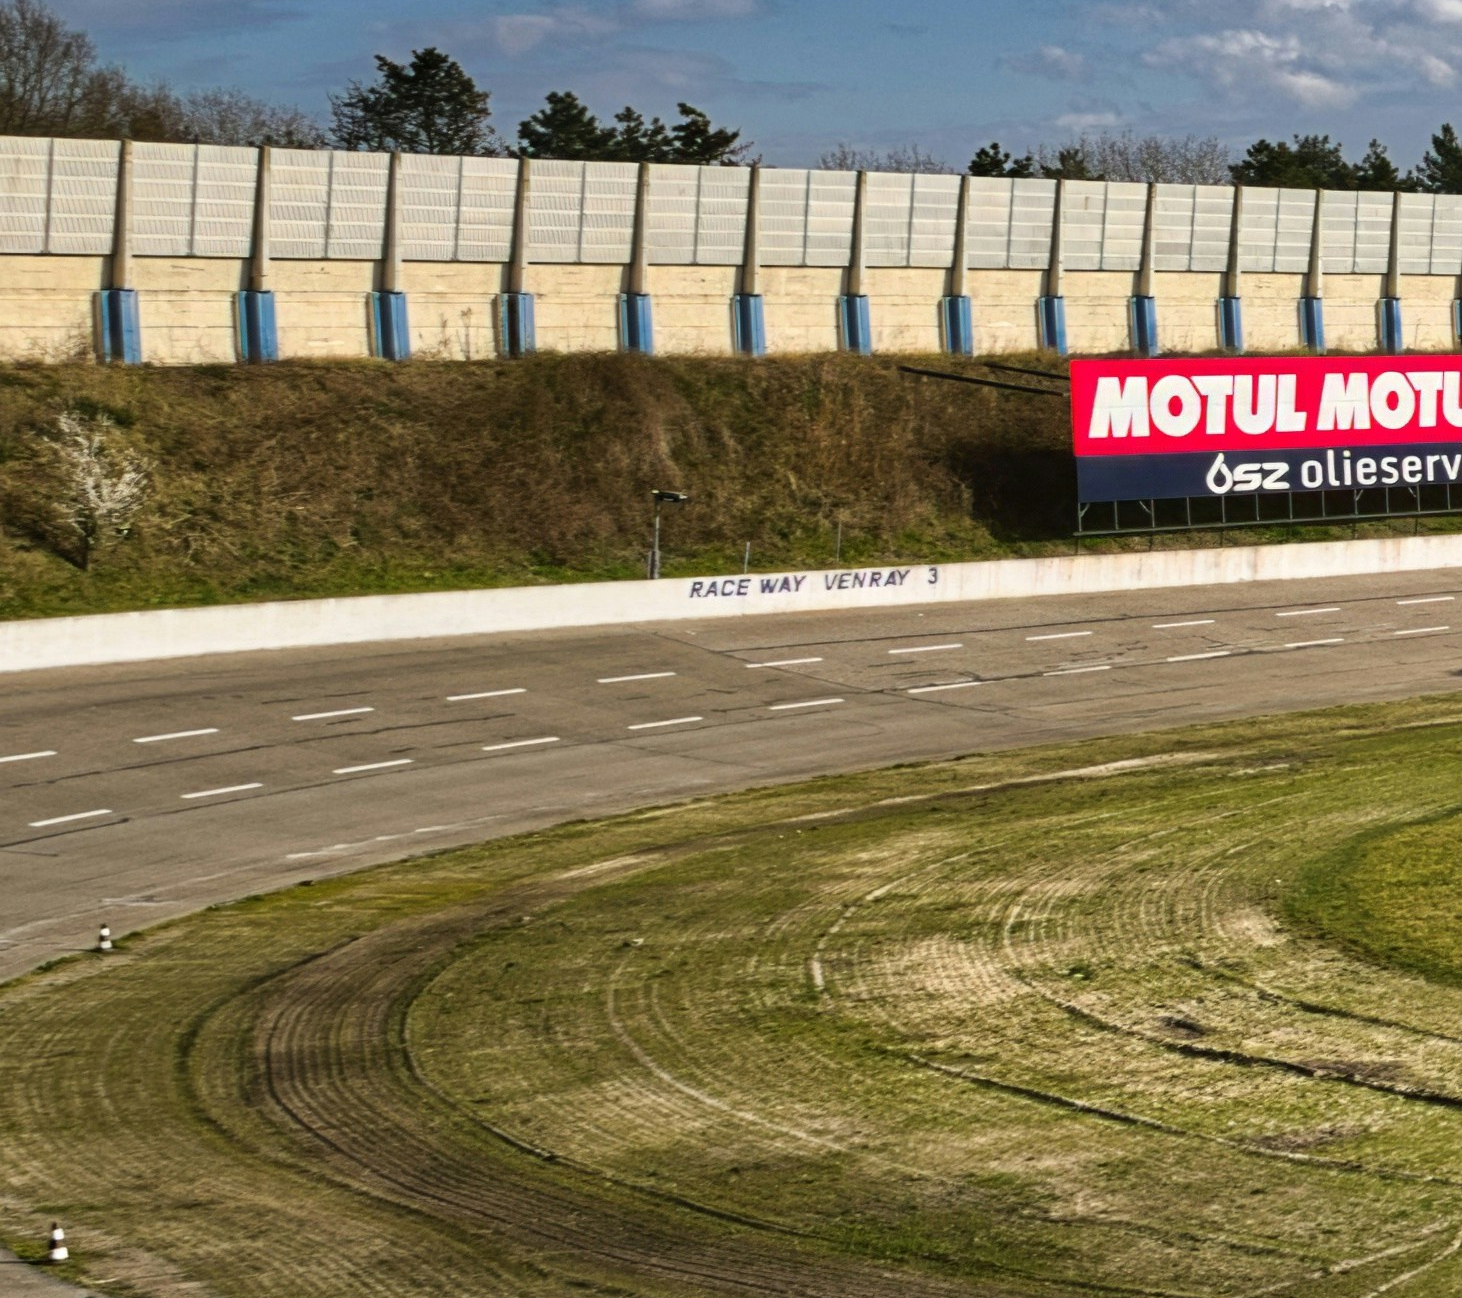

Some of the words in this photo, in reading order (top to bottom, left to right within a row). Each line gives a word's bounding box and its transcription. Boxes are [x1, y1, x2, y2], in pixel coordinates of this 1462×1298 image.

[1088, 374, 1307, 439] MOTUL
[689, 578, 752, 598] RACE
[760, 575, 808, 594] WAY
[825, 570, 911, 591] VENRAY
